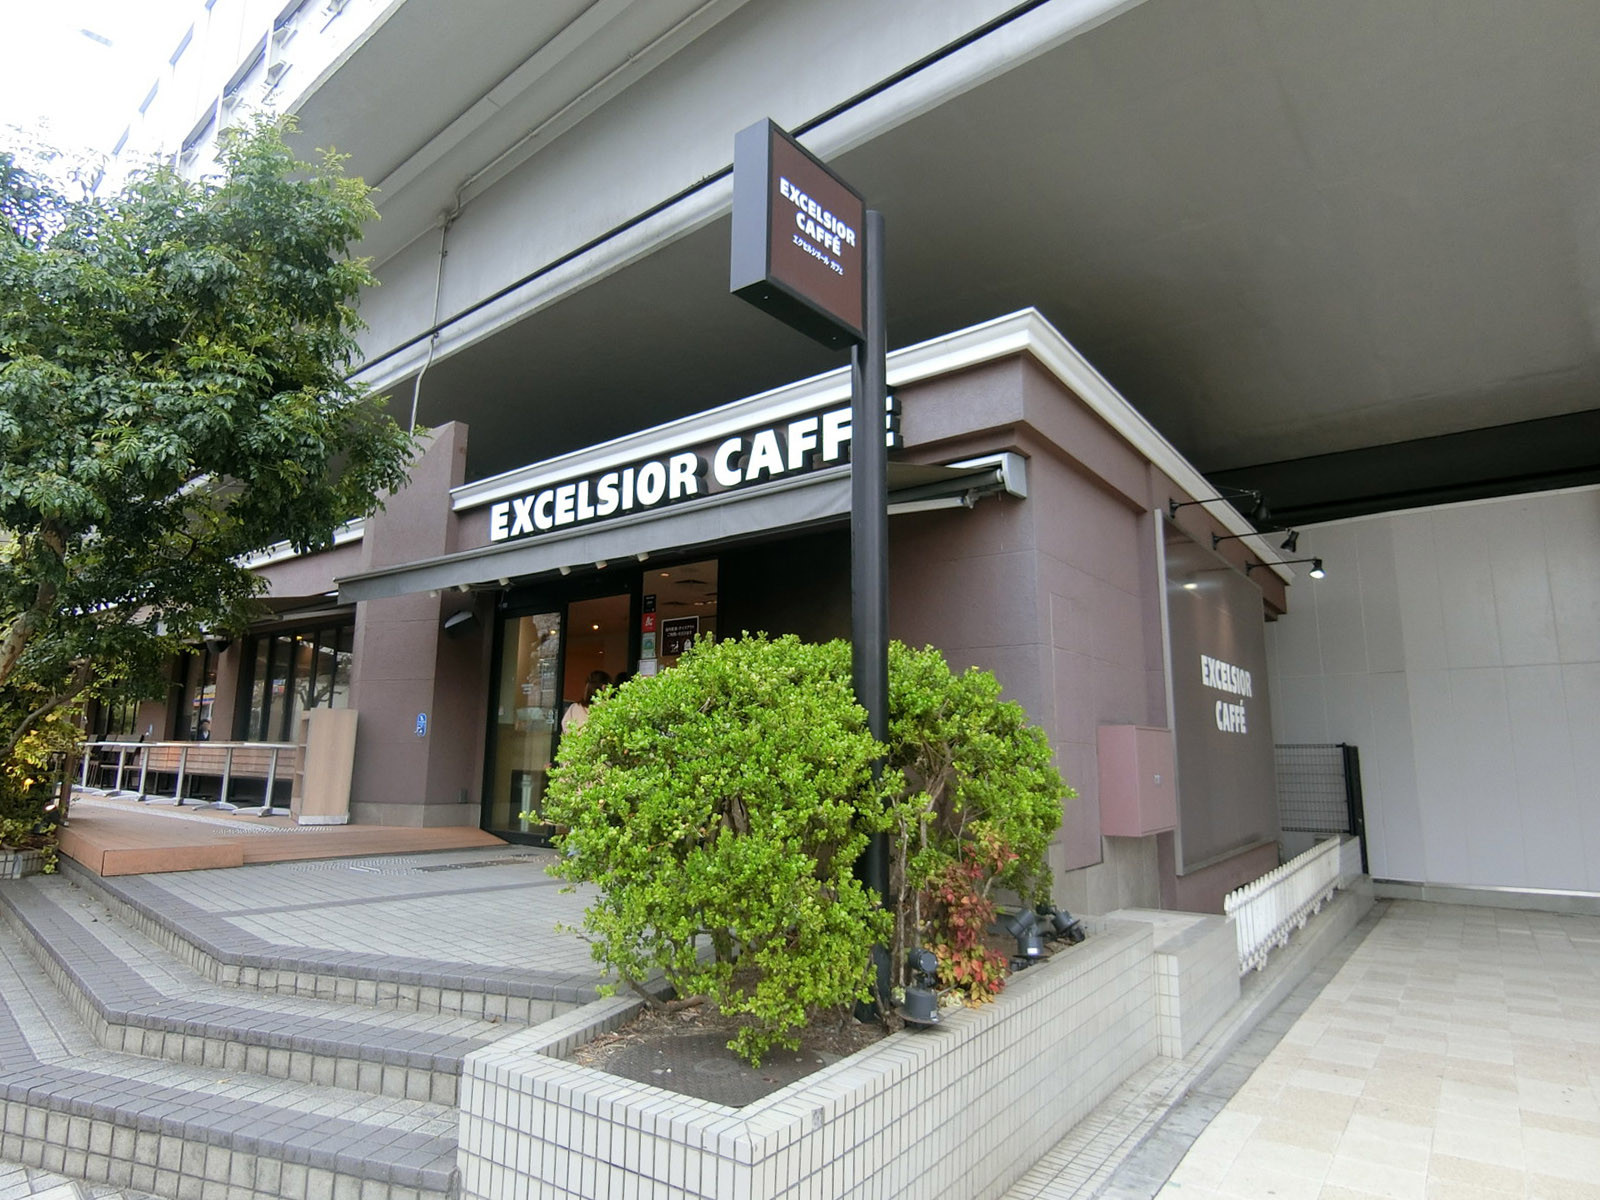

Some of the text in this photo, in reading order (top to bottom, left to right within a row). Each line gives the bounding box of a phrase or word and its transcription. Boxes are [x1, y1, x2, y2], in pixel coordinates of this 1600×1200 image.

[779, 176, 856, 248] EXCELSIOR
[795, 212, 842, 257] CAFFÉ
[830, 260, 845, 276] カフェ
[489, 395, 895, 543] EXCELSIOR CAFF
[1201, 655, 1252, 697] EXCELSIOR
[1216, 700, 1247, 733] CAFFÉ
